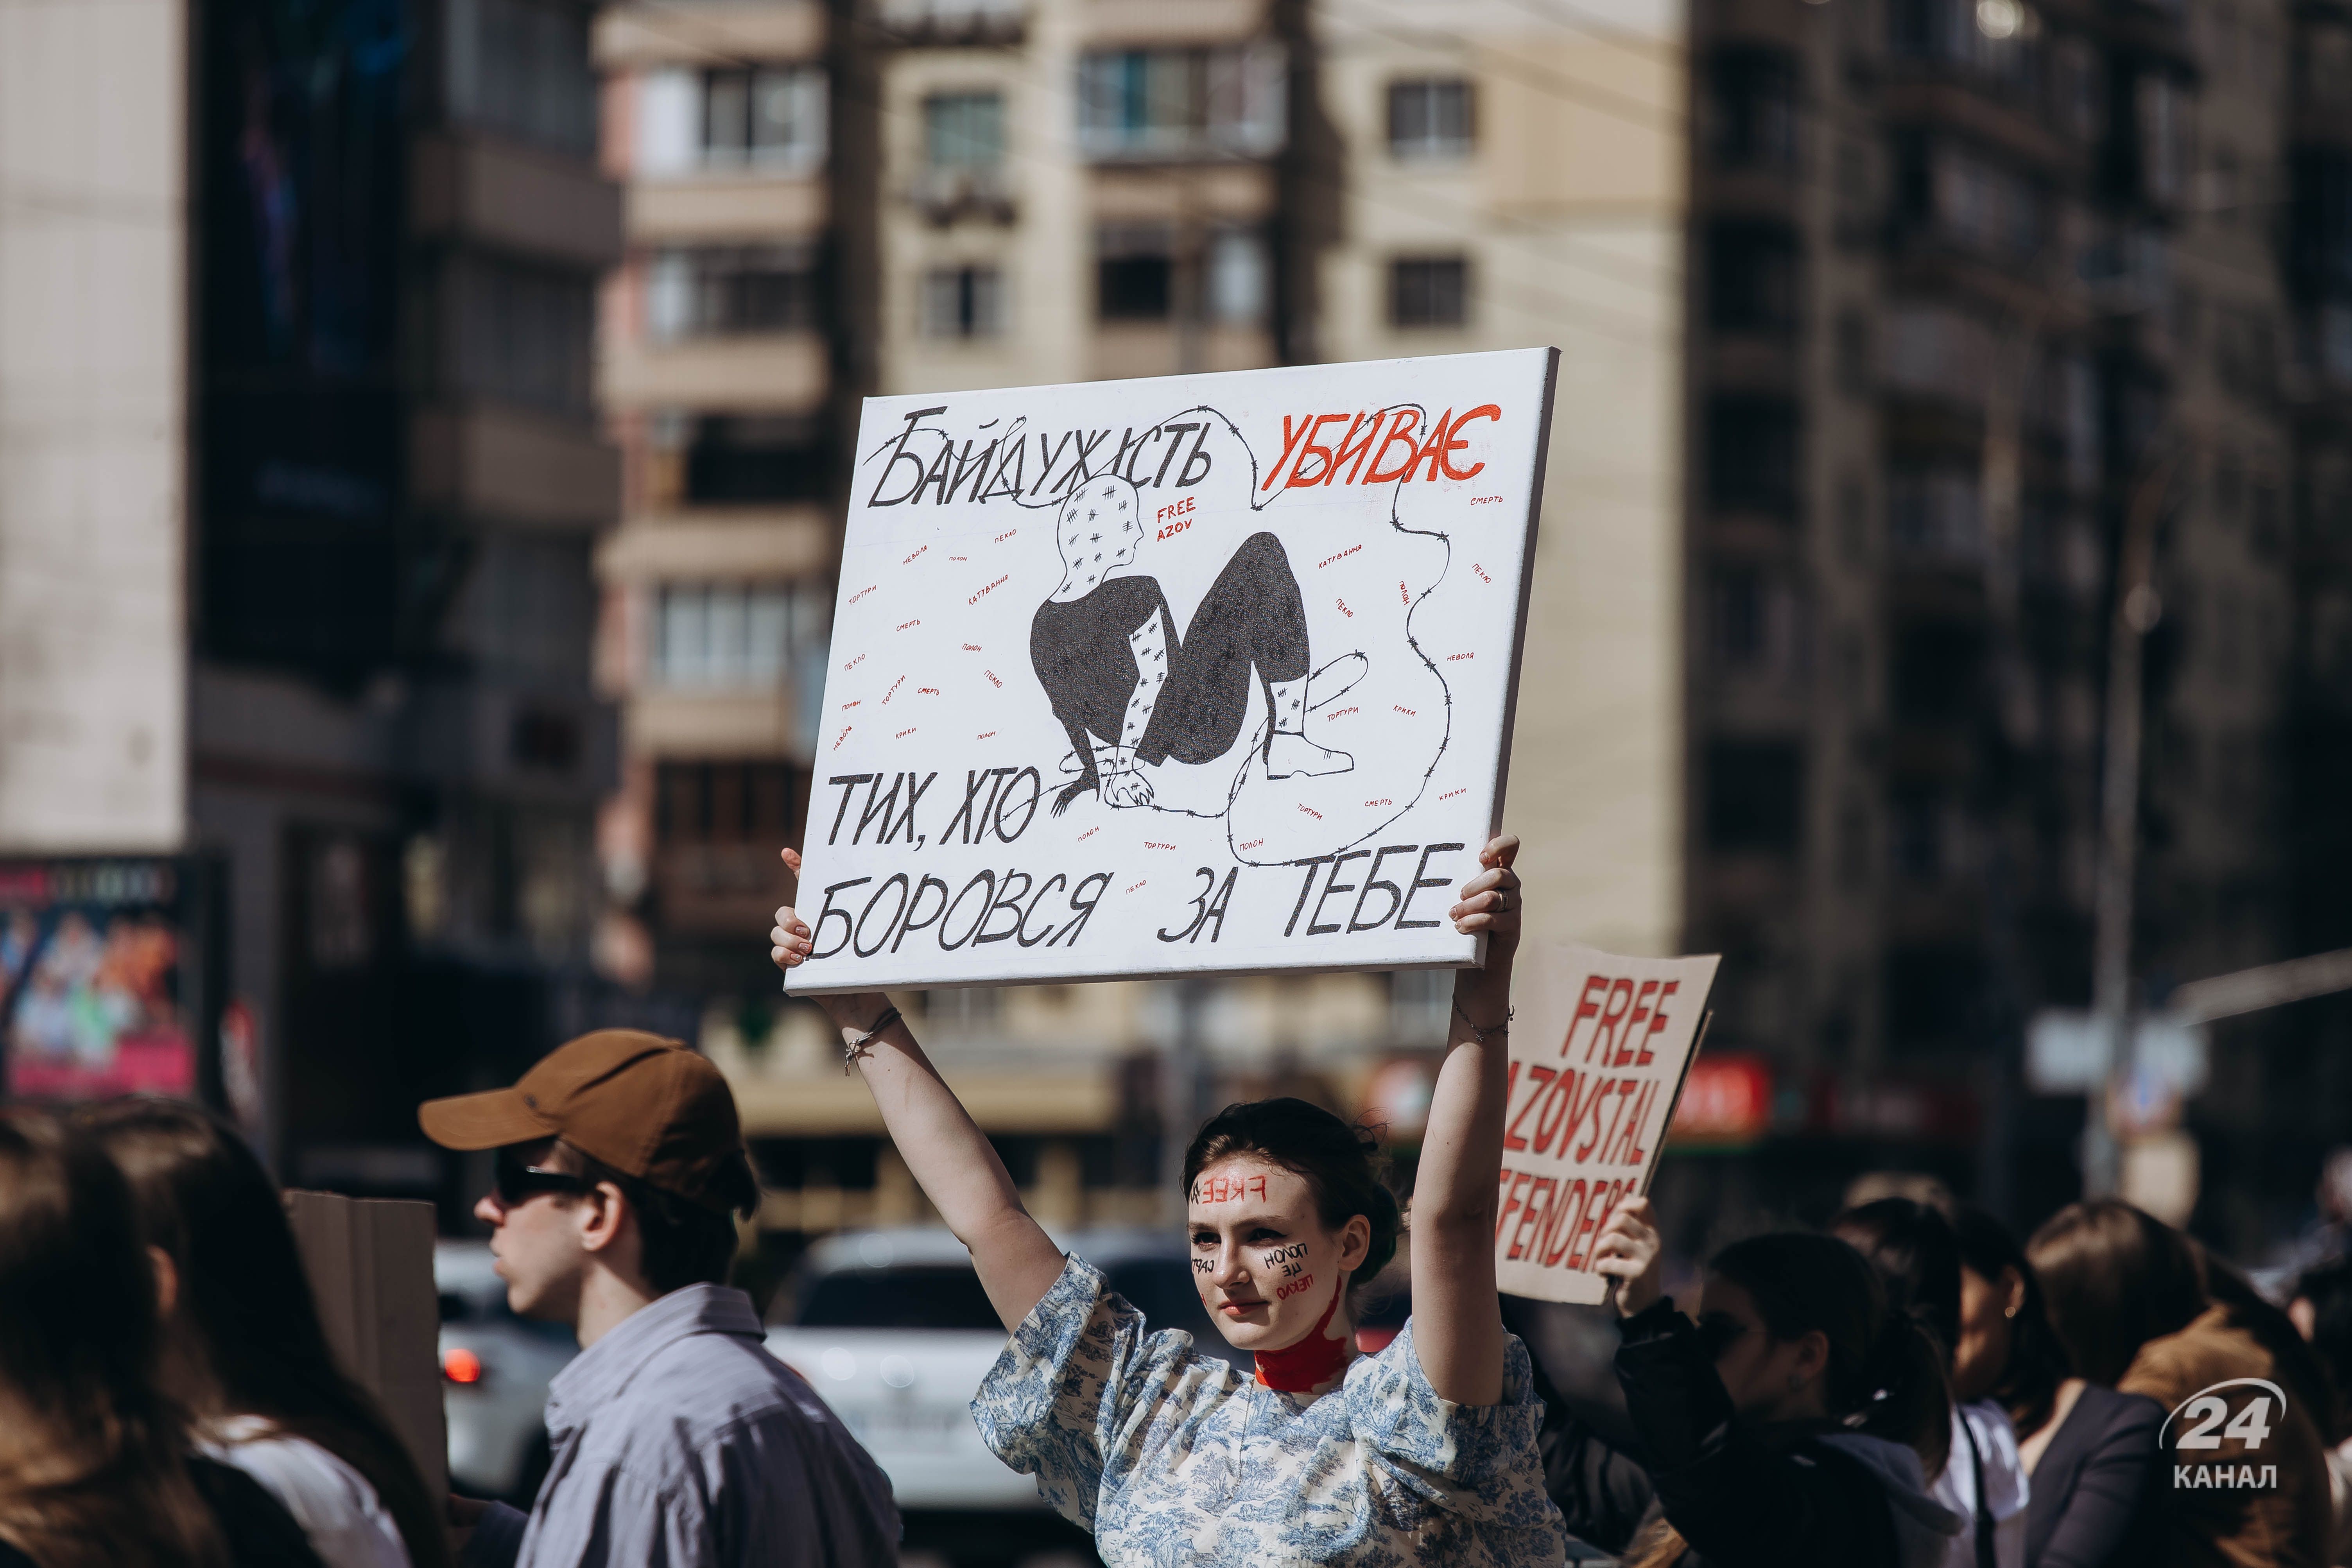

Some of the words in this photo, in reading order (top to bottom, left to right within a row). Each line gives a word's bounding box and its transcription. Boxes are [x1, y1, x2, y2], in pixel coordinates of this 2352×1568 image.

[1261, 404, 1501, 491] УБИВАЄ
[1157, 496, 1196, 523] FREE
[1470, 496, 1503, 505] СМЕРТЬ
[994, 529, 1016, 543] ПЕКЛО
[1157, 518, 1192, 542] AZOV
[903, 545, 927, 565] НЕВОЛЯ
[1318, 544, 1362, 569] КАТУВАННЯ
[1472, 563, 1491, 584] ПЕКЛО
[848, 585, 877, 605] ТОРТУРИ
[968, 574, 1009, 606] КАТУВАННЯ
[1399, 581, 1410, 606] ПОЛОН
[1336, 598, 1353, 618] ПЕКЛО
[896, 619, 920, 632] СМЕРТЬ
[844, 654, 866, 672] ПЕКЛО
[1447, 652, 1474, 661] НЕВОЛЯ
[984, 670, 1003, 688] ПЕКЛО
[882, 675, 905, 706] ТОРТУРИ
[917, 687, 939, 696] СМЕРТЬ
[842, 700, 861, 711] ПОЛОН
[1327, 706, 1359, 722] ТОРТУРИ
[1393, 704, 1416, 717] КРИКИ
[833, 726, 852, 751] НЕВОЛЯ
[895, 727, 916, 739] КРИКИ
[977, 731, 996, 740] ПОЛОН
[1364, 799, 1392, 807] СМЕРТЬ
[1439, 788, 1467, 801] КРИКИ
[828, 771, 938, 851] ТИХ,
[938, 766, 1041, 845] ХТО
[1297, 803, 1323, 821] ТОРТУРИ
[1077, 826, 1099, 843] ПОЛОН
[1144, 842, 1176, 851] ТОРТУРИ
[1239, 838, 1264, 851] ПОЛОН
[1126, 880, 1147, 895] ПЕКЛО
[805, 868, 1115, 961] БОРОВСЯ
[1157, 867, 1239, 944] ЗА
[1284, 843, 1465, 937] ТЕБЕ
[1560, 975, 1681, 1068] FREE
